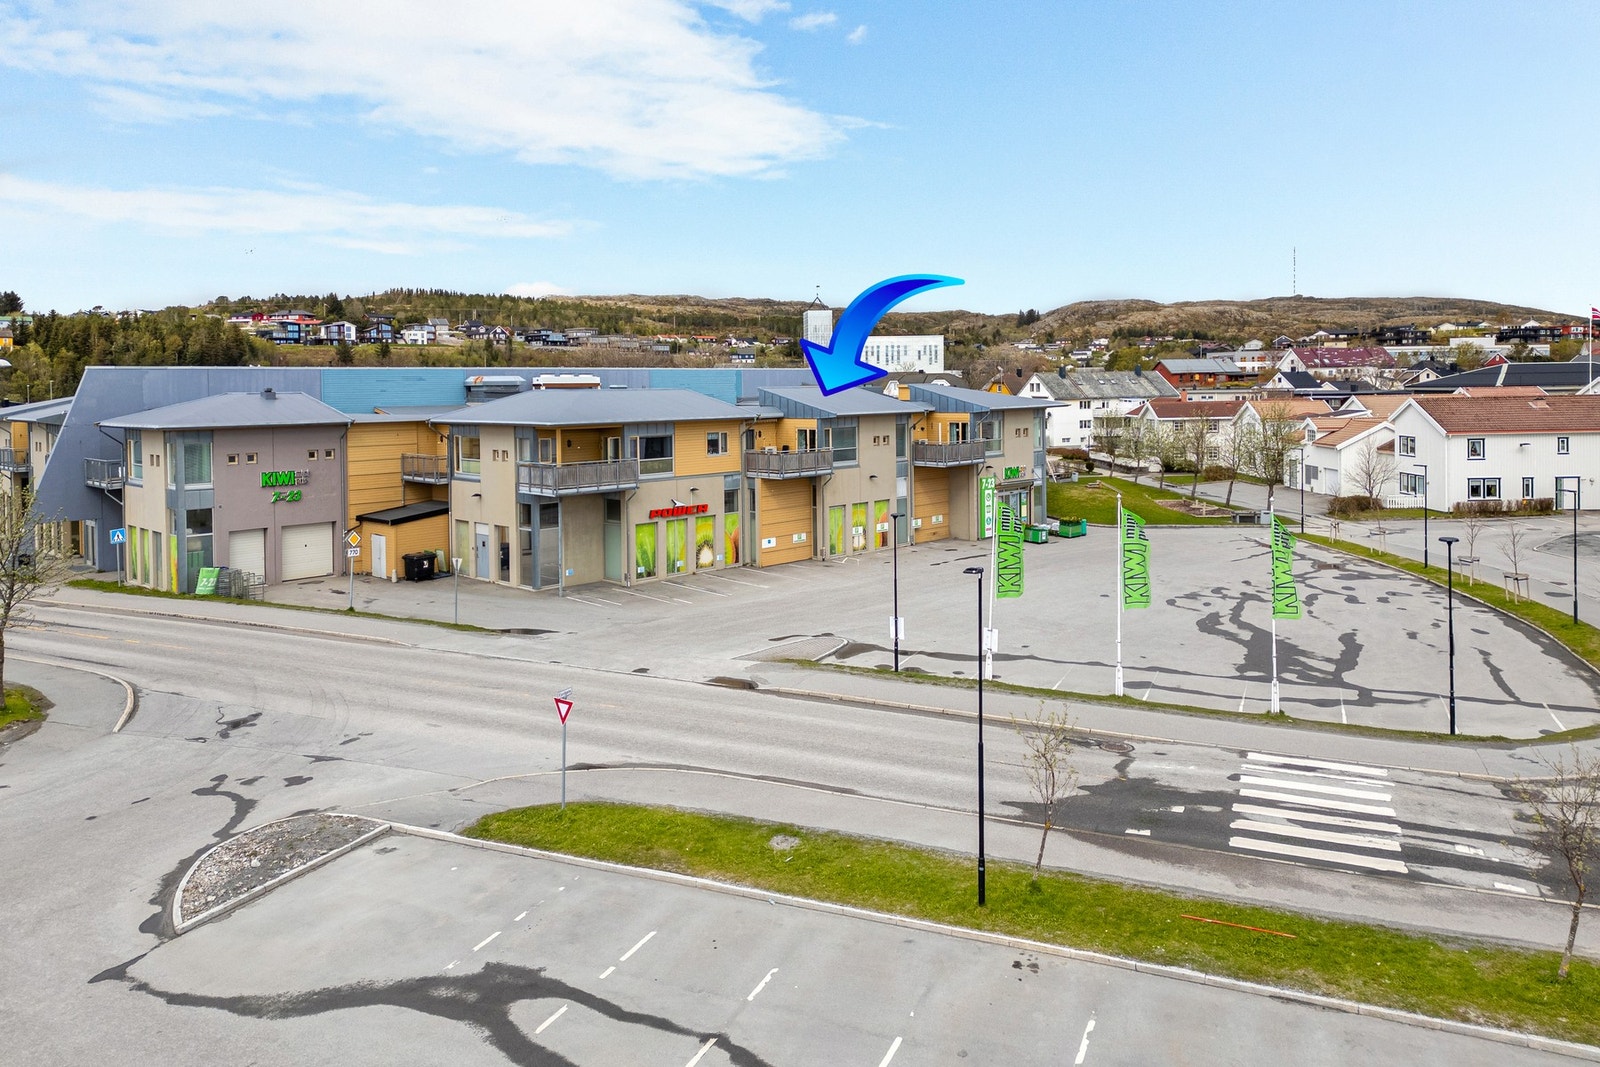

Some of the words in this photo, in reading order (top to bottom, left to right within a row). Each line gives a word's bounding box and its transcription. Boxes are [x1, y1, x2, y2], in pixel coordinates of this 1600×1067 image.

[261, 471, 296, 488] KIWI
[982, 478, 995, 489] 7-23
[271, 489, 302, 503] 7-23
[649, 504, 708, 519] POWER
[998, 506, 1011, 532] mini
[998, 534, 1021, 593] KIWI
[1123, 542, 1149, 604] KIWI
[1271, 549, 1299, 615] KIWI
